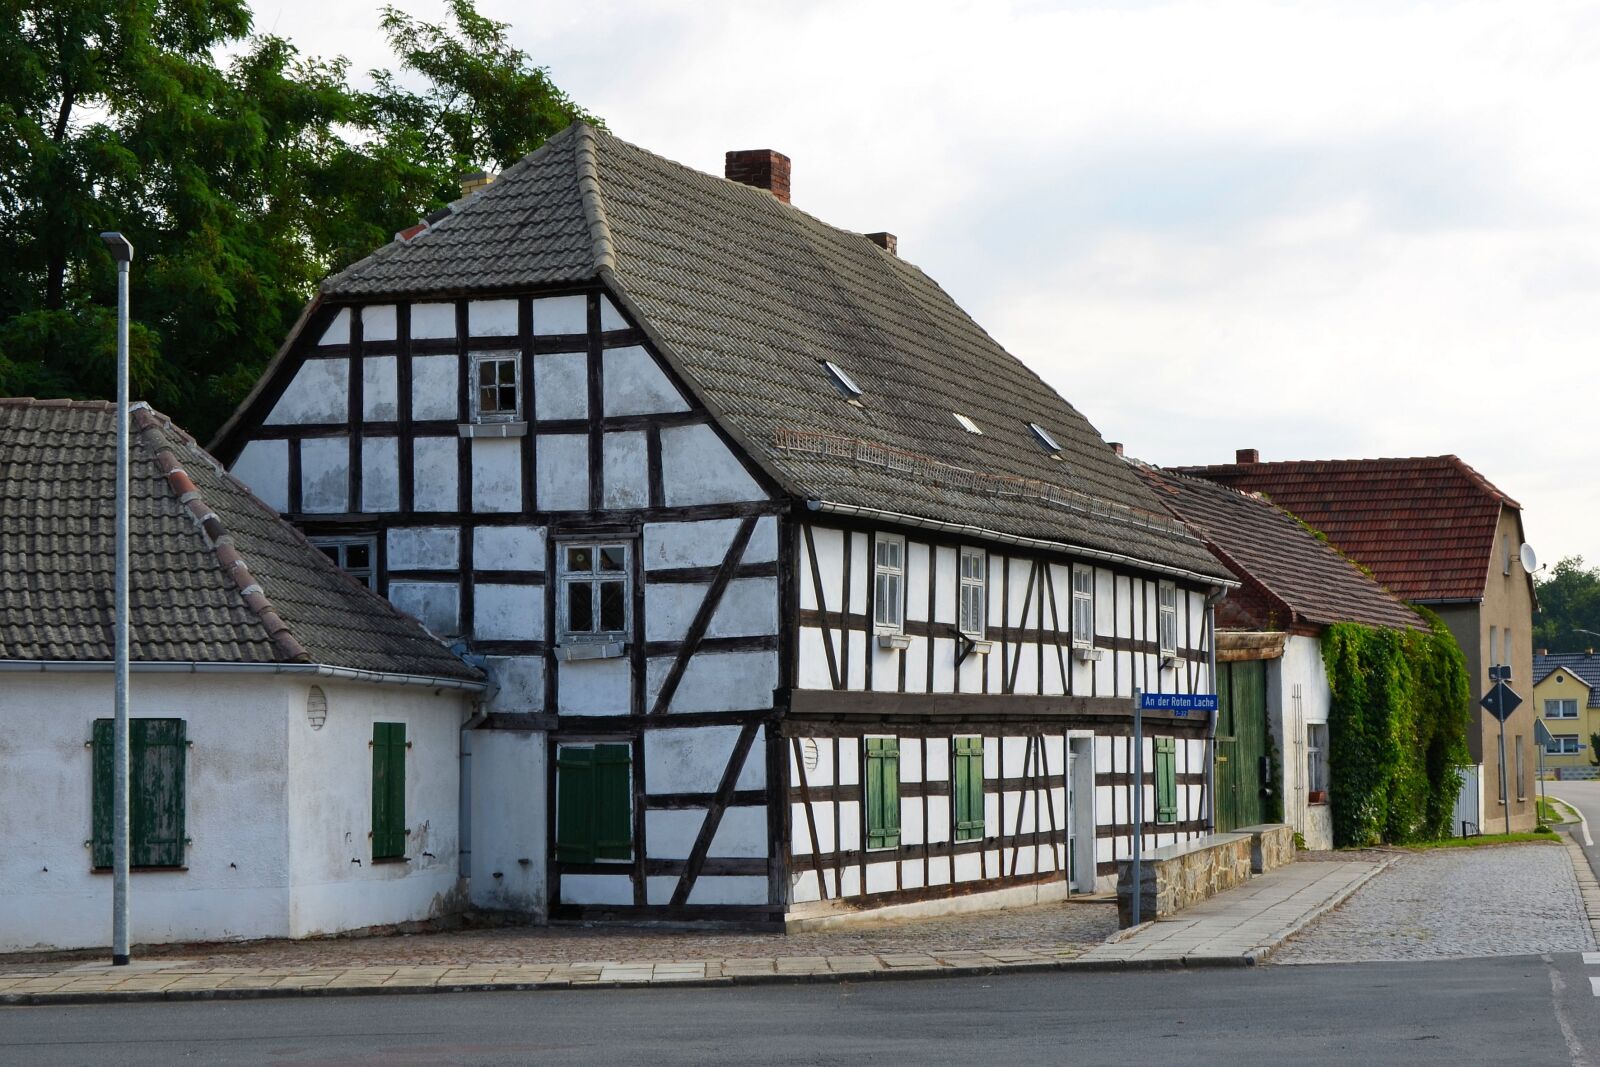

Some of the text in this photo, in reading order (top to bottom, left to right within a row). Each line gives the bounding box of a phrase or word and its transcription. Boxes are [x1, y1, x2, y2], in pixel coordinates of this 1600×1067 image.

[1145, 696, 1214, 707] An der Roten Lache
